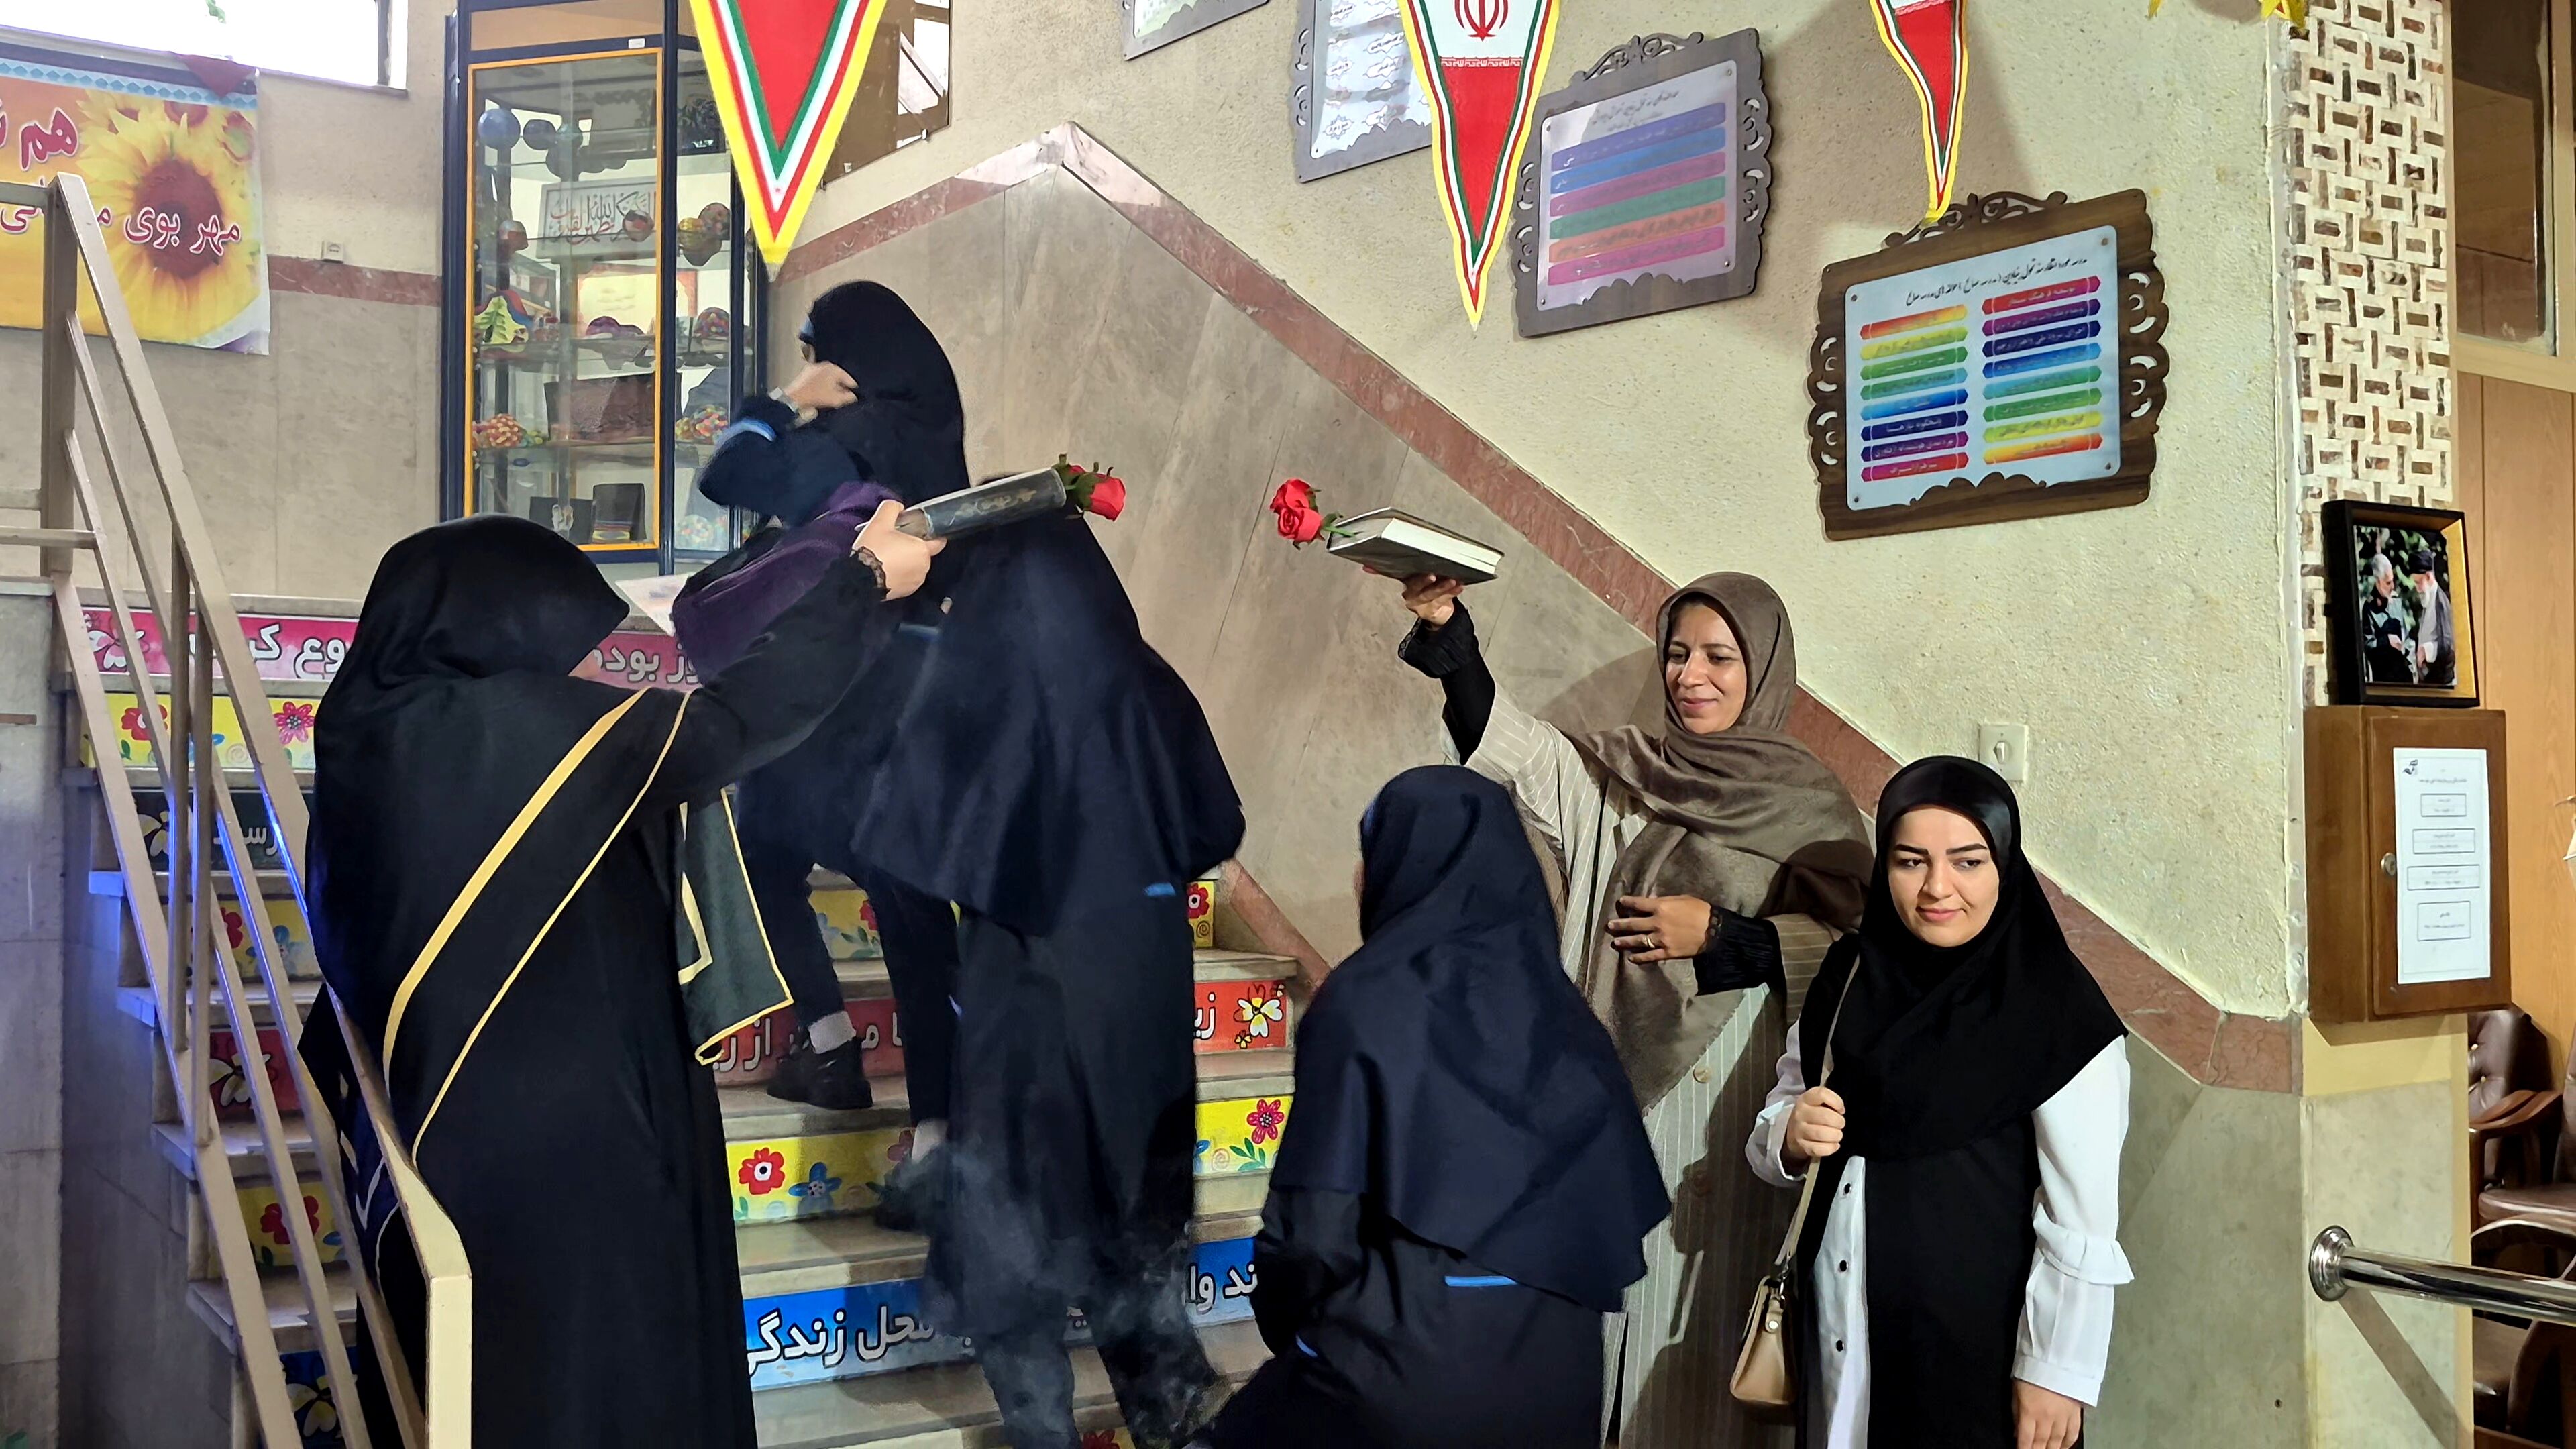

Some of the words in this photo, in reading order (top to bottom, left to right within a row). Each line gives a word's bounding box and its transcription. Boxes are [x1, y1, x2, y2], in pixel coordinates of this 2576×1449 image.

[19, 106, 79, 172] هم
[123, 206, 182, 250] بوی
[189, 215, 242, 256] مهر
